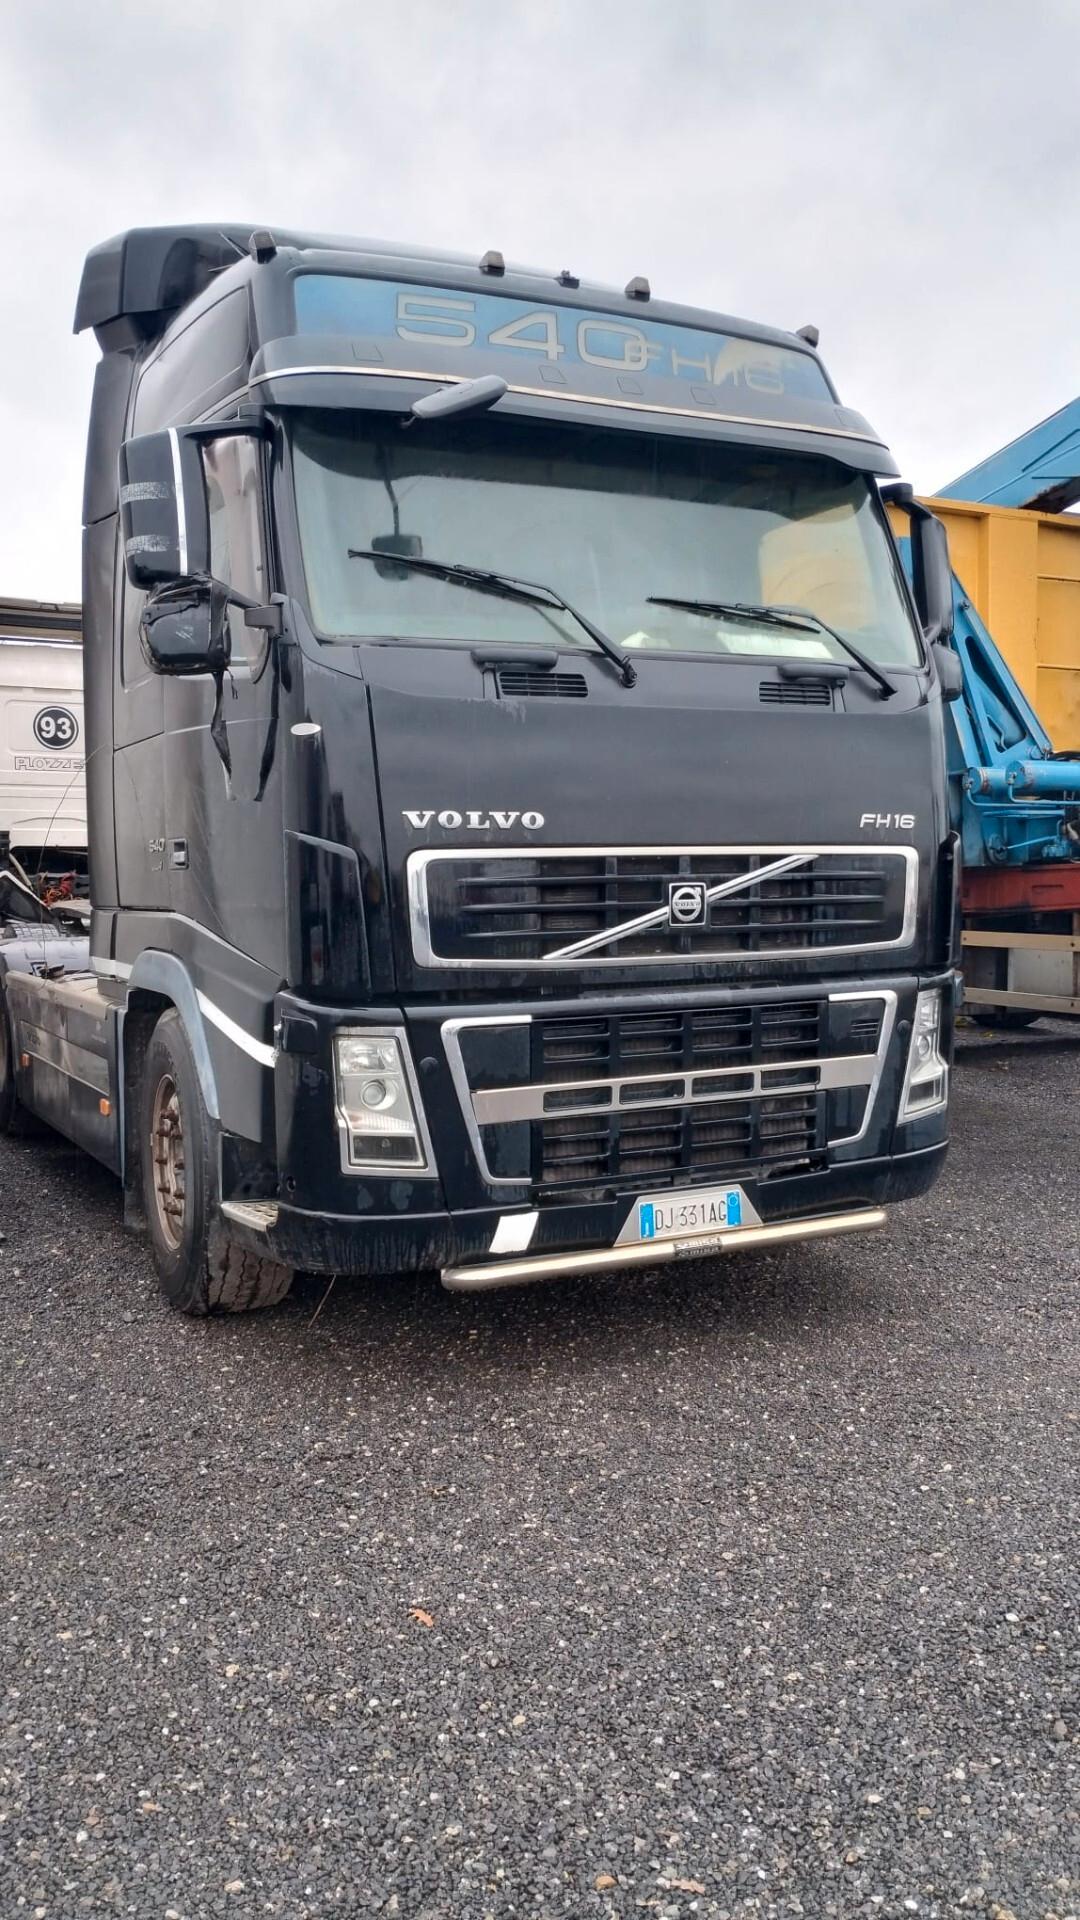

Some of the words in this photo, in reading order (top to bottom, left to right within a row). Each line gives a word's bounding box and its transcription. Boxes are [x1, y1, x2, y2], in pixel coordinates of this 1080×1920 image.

[396, 292, 649, 372] 540
[40, 716, 72, 739] 93
[401, 810, 545, 830] VOLVO
[859, 813, 915, 829] FH16
